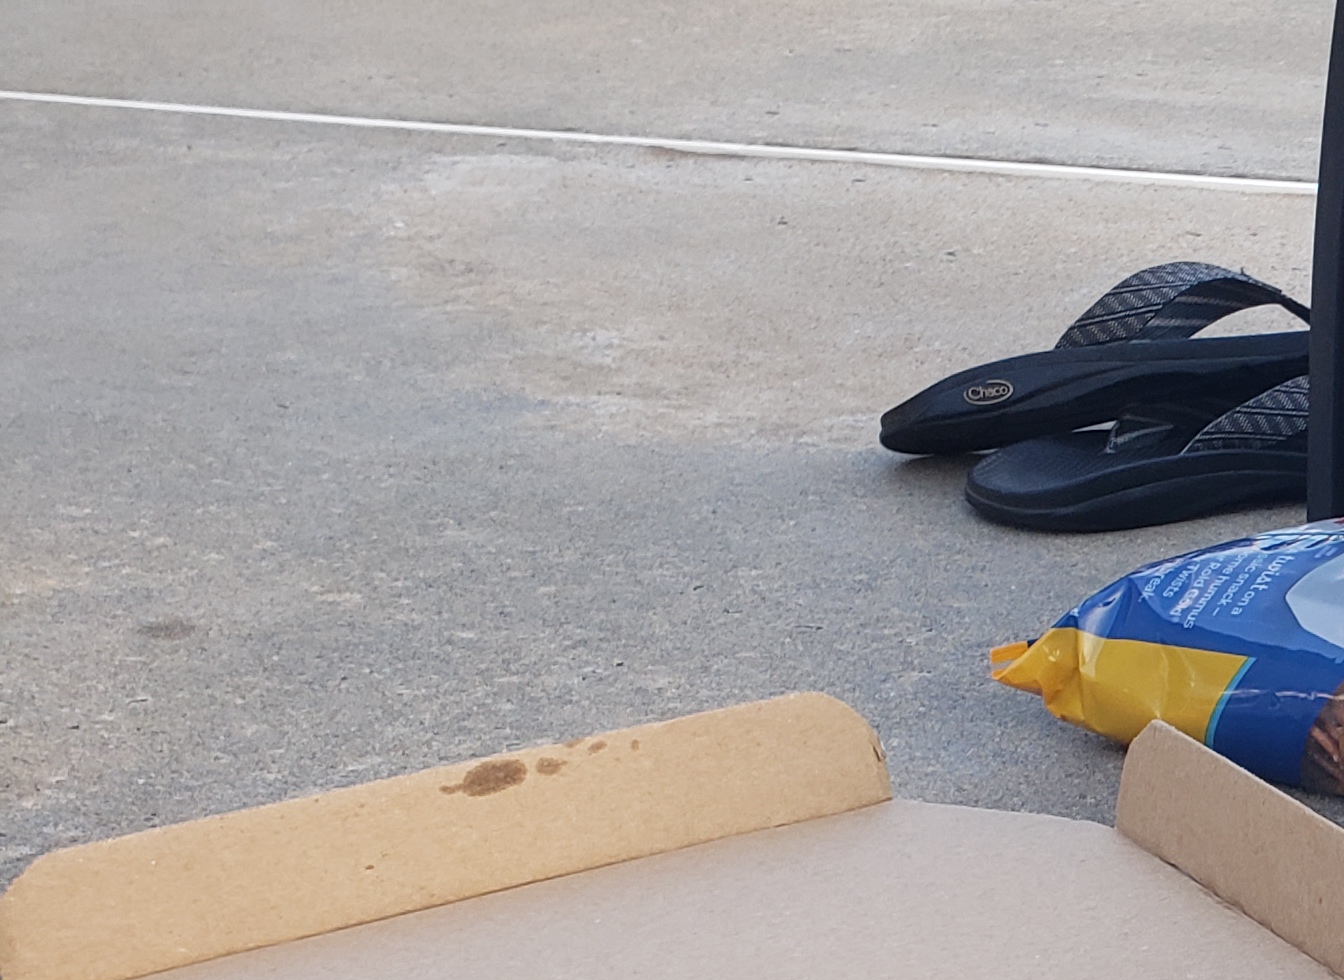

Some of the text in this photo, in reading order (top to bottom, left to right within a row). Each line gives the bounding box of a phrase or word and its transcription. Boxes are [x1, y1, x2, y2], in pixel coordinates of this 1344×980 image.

[968, 385, 1008, 400] Chaco
[1162, 562, 1201, 598] Twists
[1183, 553, 1249, 629] ome hummus
[1193, 562, 1222, 588] Rold
[1217, 573, 1250, 606] snack
[1230, 555, 1295, 615] twist on a
